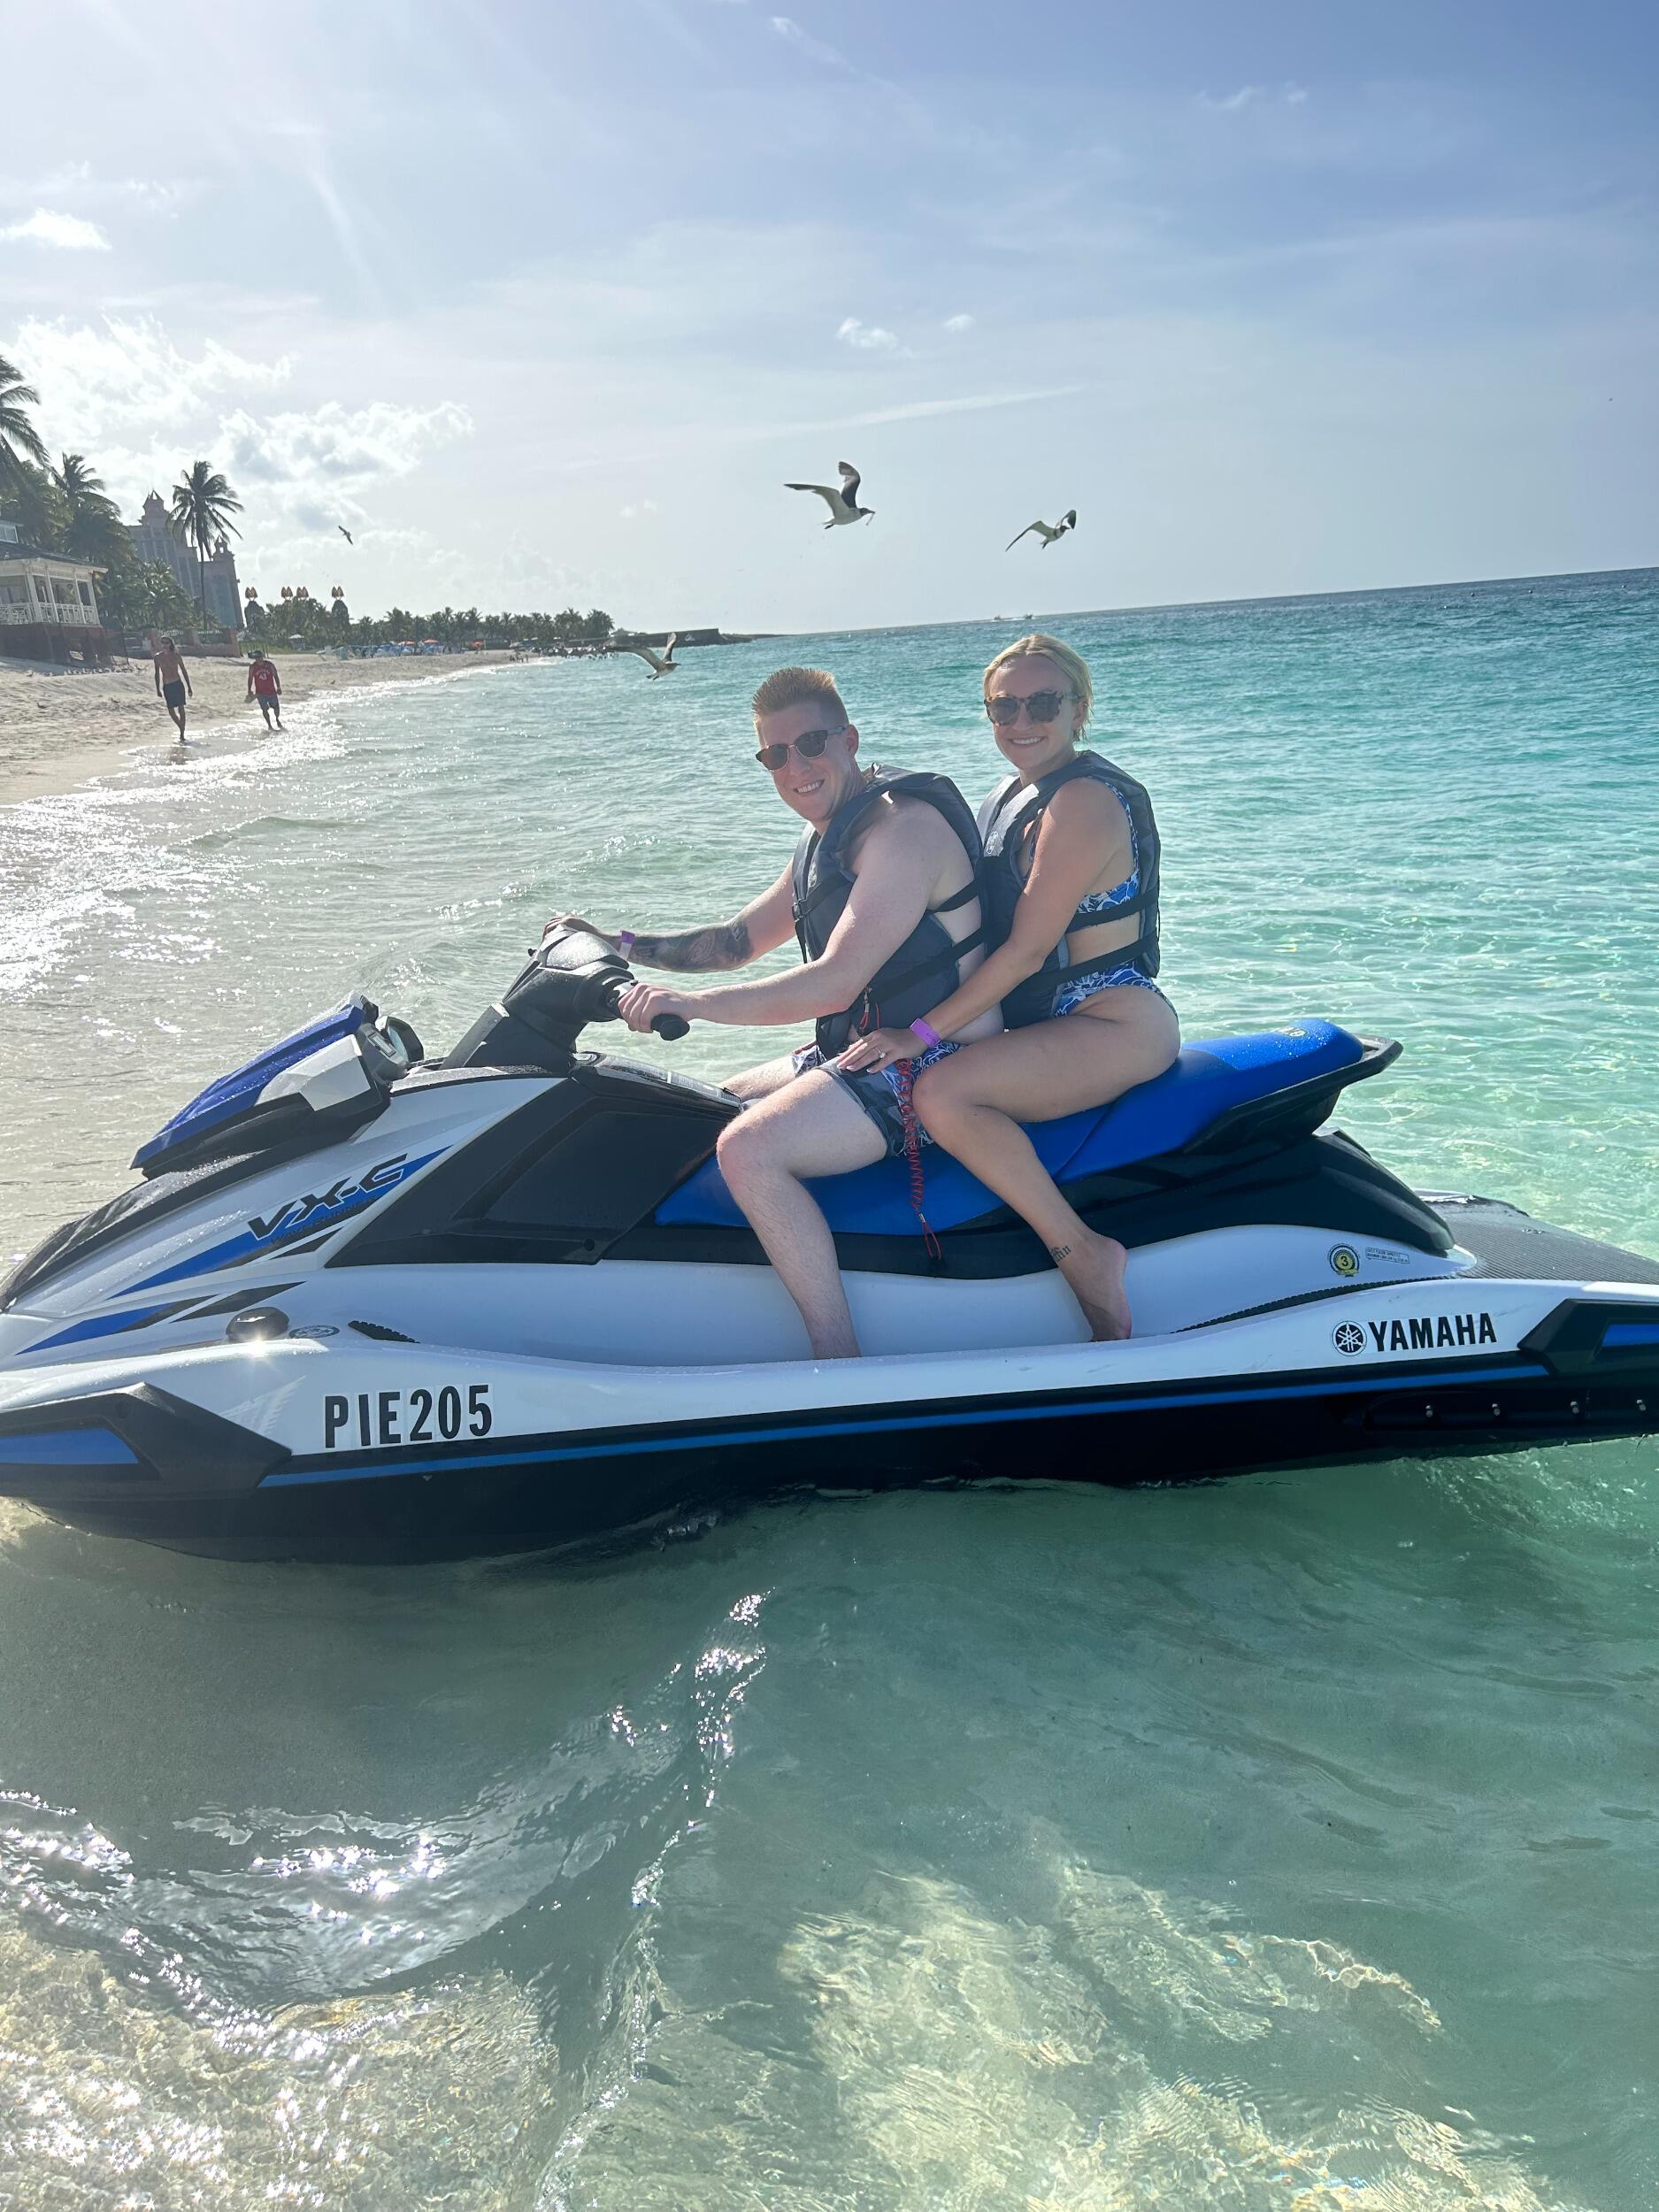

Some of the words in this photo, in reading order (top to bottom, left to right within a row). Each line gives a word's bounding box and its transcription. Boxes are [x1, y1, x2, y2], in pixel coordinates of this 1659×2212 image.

[1340, 1256, 1348, 1267] 3
[1368, 1312, 1498, 1352] YAMAHA
[324, 1384, 493, 1448] PIE205
